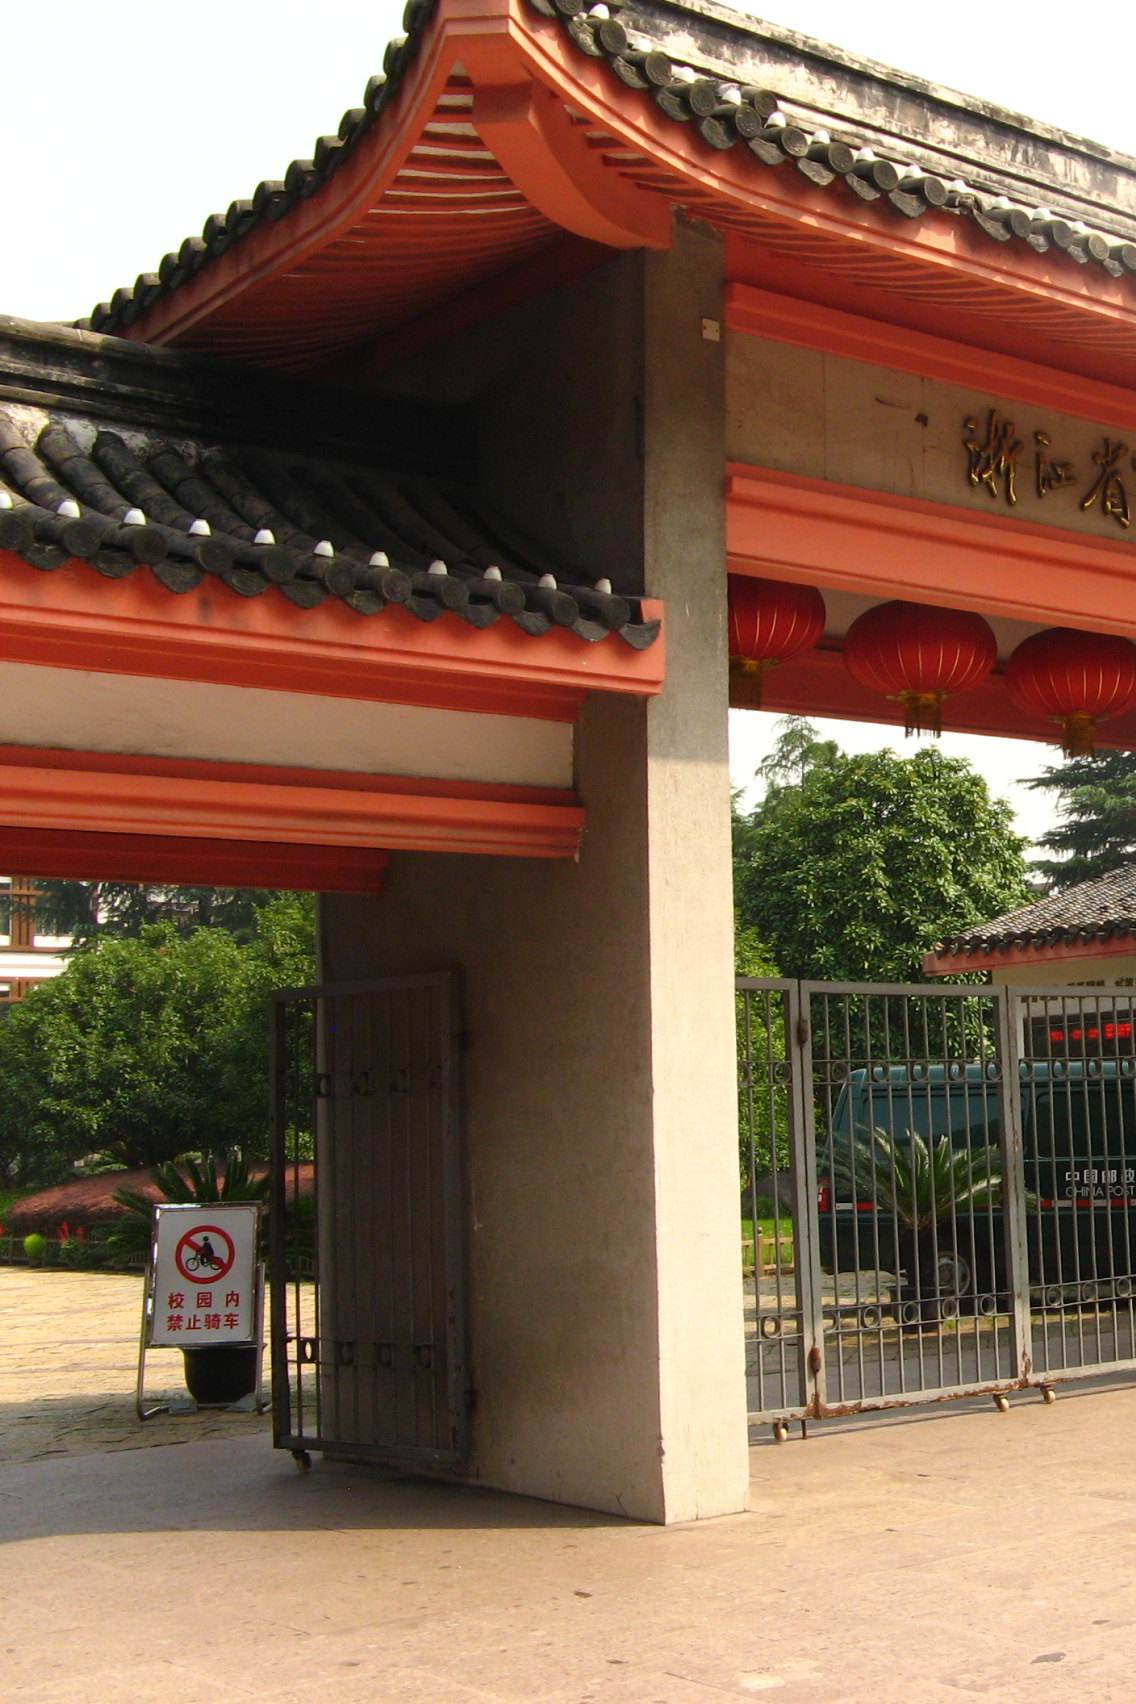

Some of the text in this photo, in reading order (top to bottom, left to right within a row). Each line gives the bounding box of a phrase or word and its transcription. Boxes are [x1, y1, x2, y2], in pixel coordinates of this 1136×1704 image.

[1065, 1168, 1136, 1184] 中国邮政
[1065, 1185, 1136, 1197] CHINA POST
[168, 1290, 240, 1309] 校园内
[167, 1312, 240, 1332] 禁止骑车
